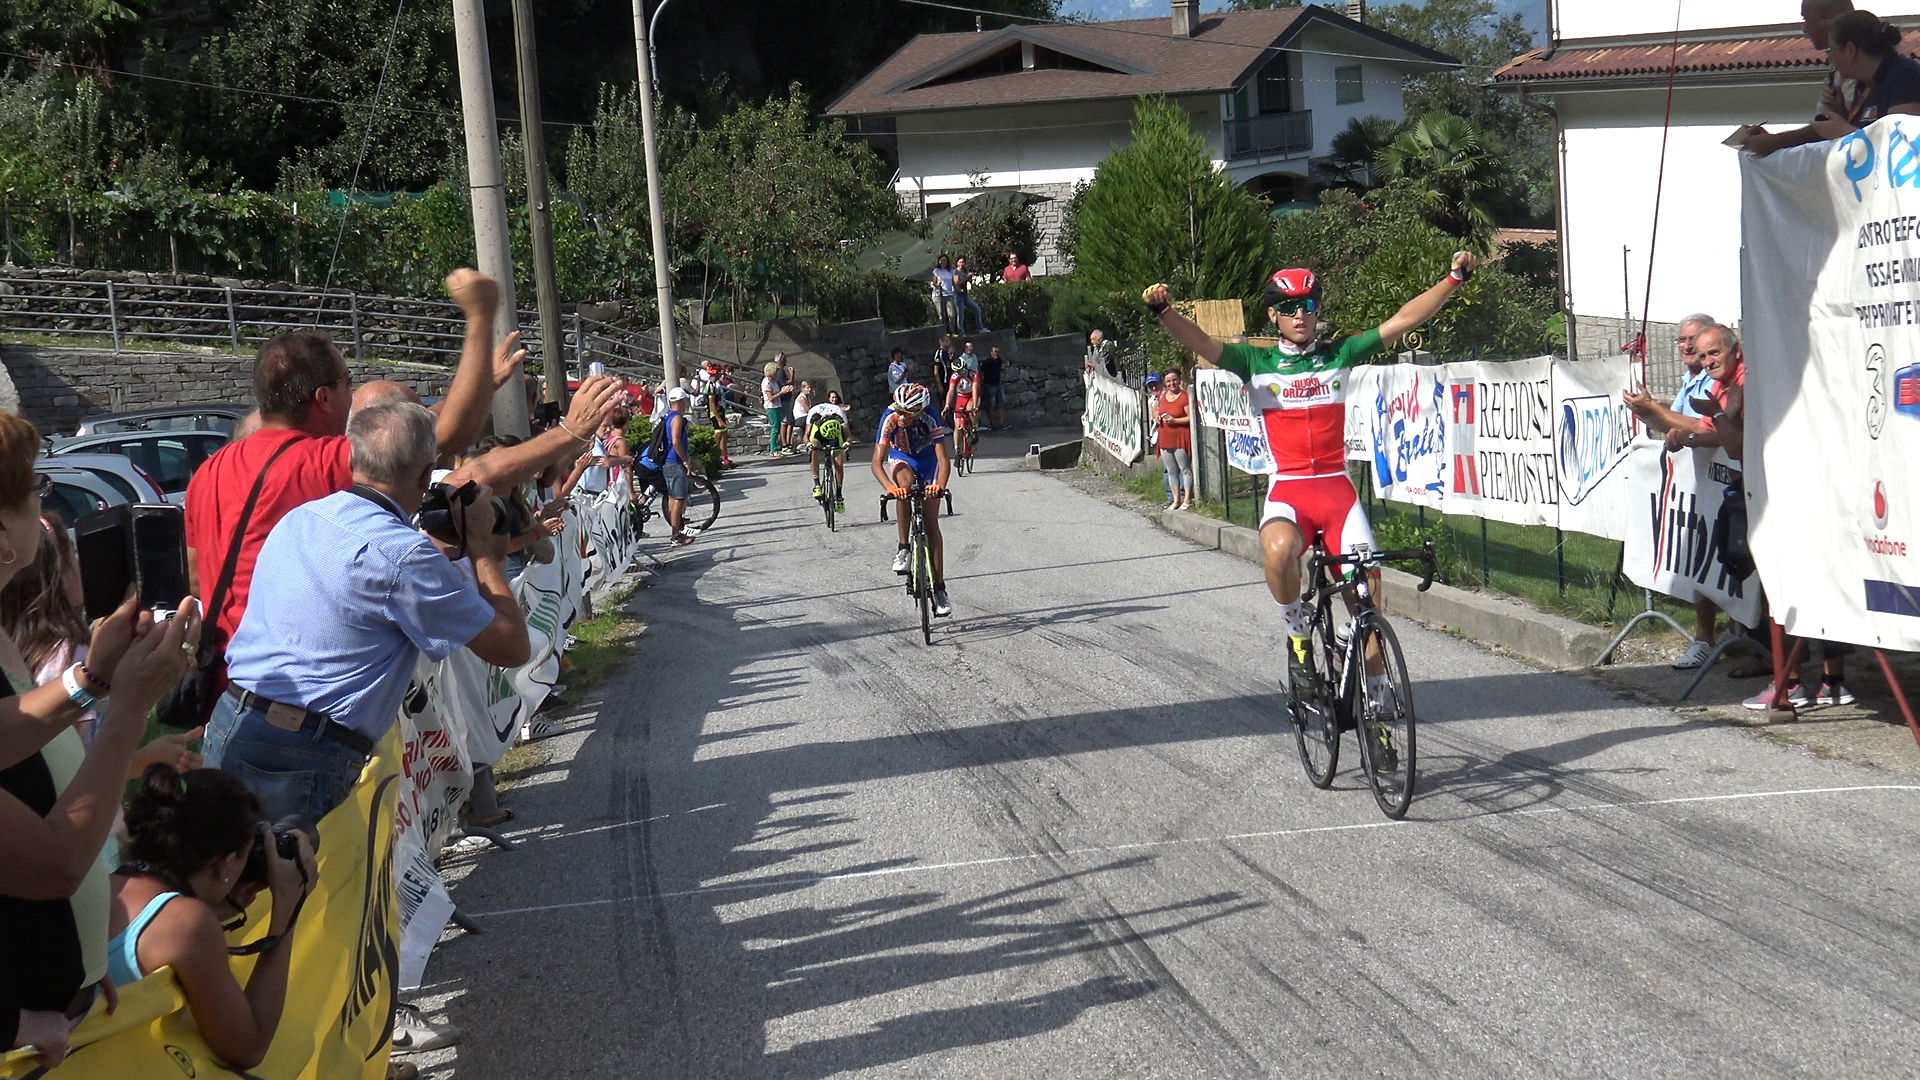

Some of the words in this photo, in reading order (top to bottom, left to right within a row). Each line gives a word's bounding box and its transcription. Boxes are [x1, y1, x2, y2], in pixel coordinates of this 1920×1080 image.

[1282, 384, 1330, 399] ORIZZONTI
[1479, 379, 1551, 441] REGIONE
[1479, 450, 1558, 505] PIEMONTE
[1864, 534, 1907, 557] vodafone
